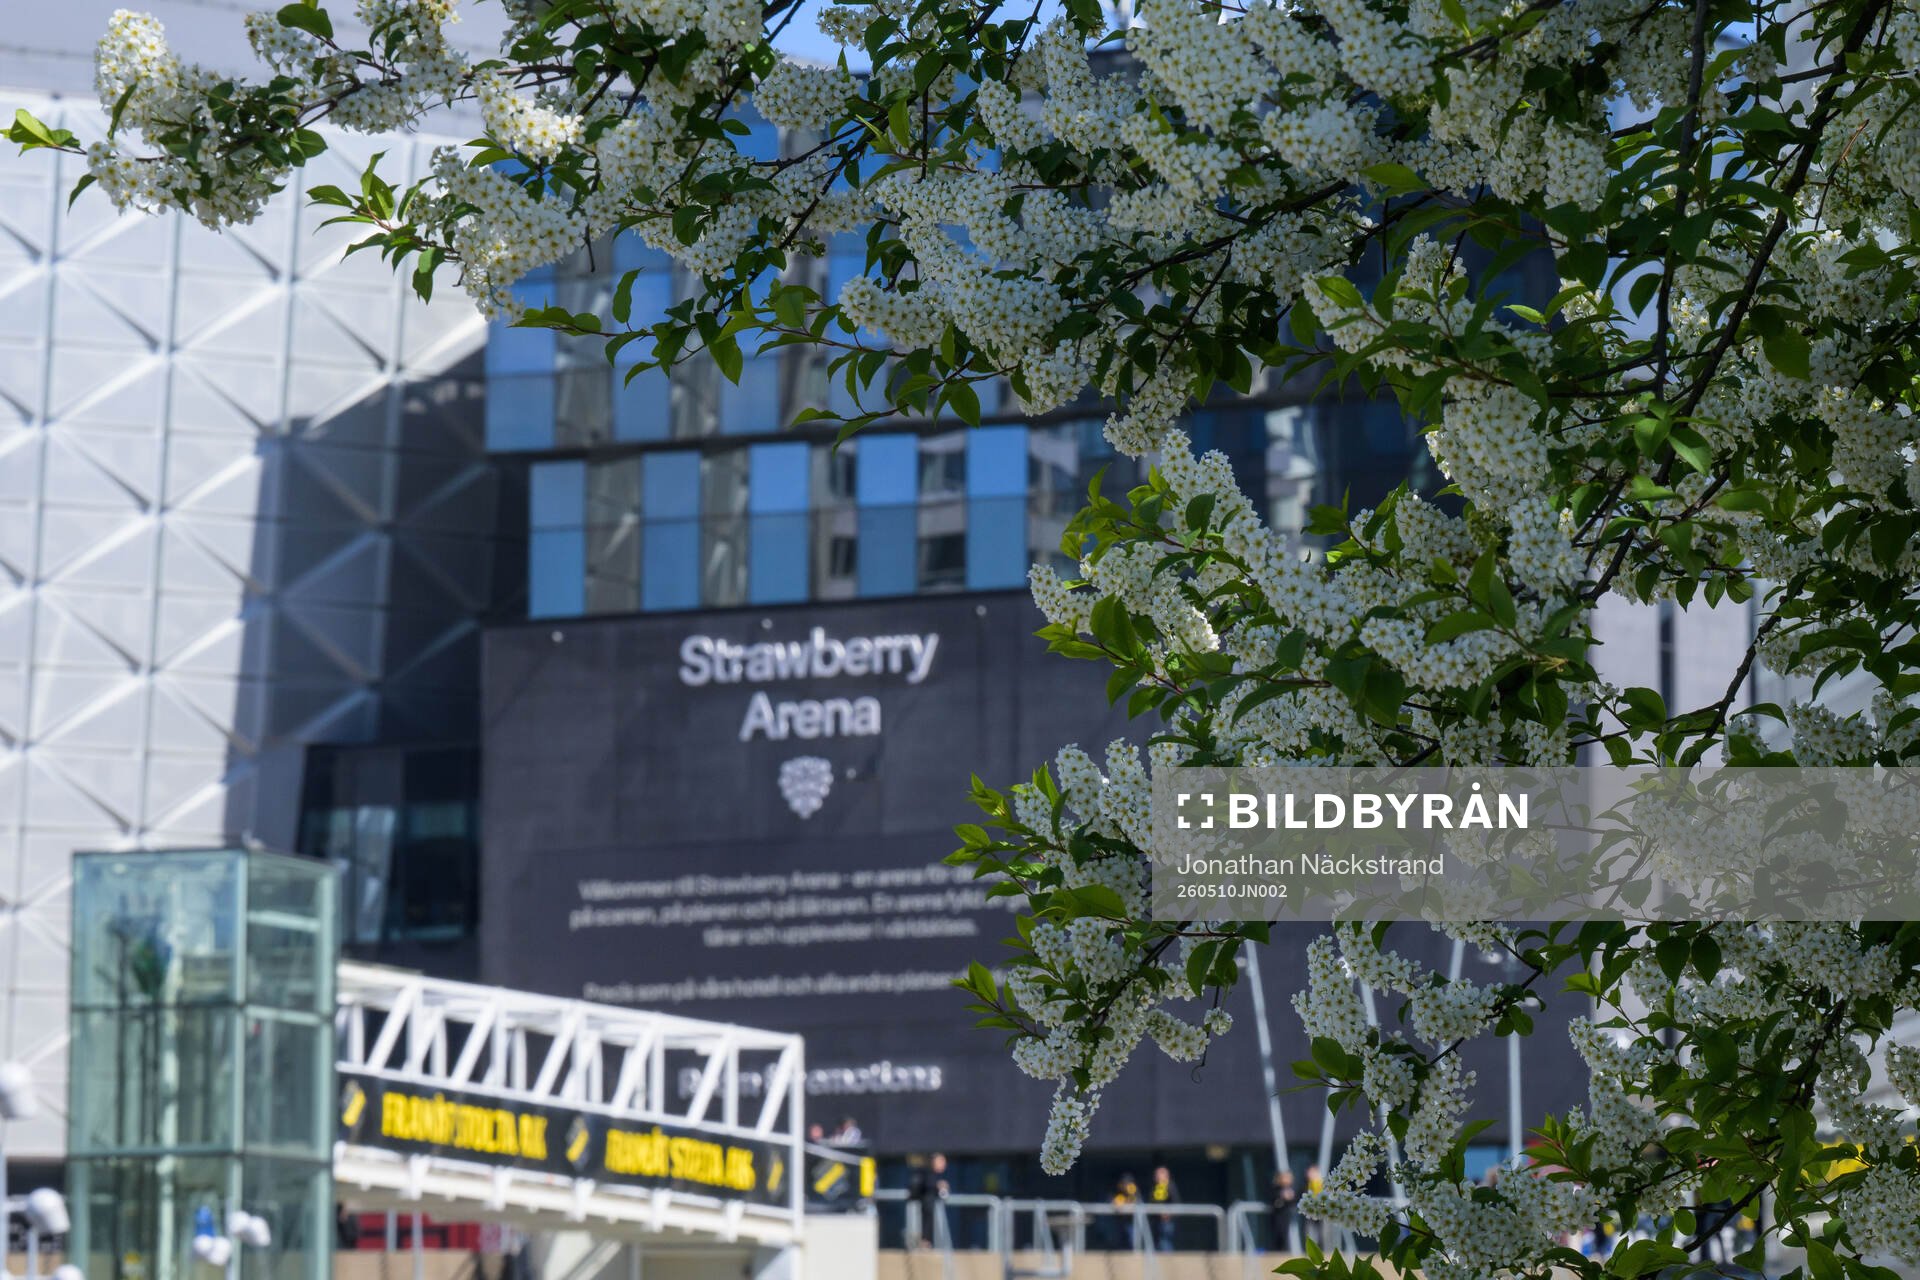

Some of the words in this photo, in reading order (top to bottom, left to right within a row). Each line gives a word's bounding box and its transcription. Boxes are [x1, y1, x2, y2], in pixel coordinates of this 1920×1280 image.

[679, 627, 939, 686] Strawberry
[739, 691, 882, 741] Arena
[790, 869, 841, 890] Arena
[806, 1061, 942, 1095] emotions
